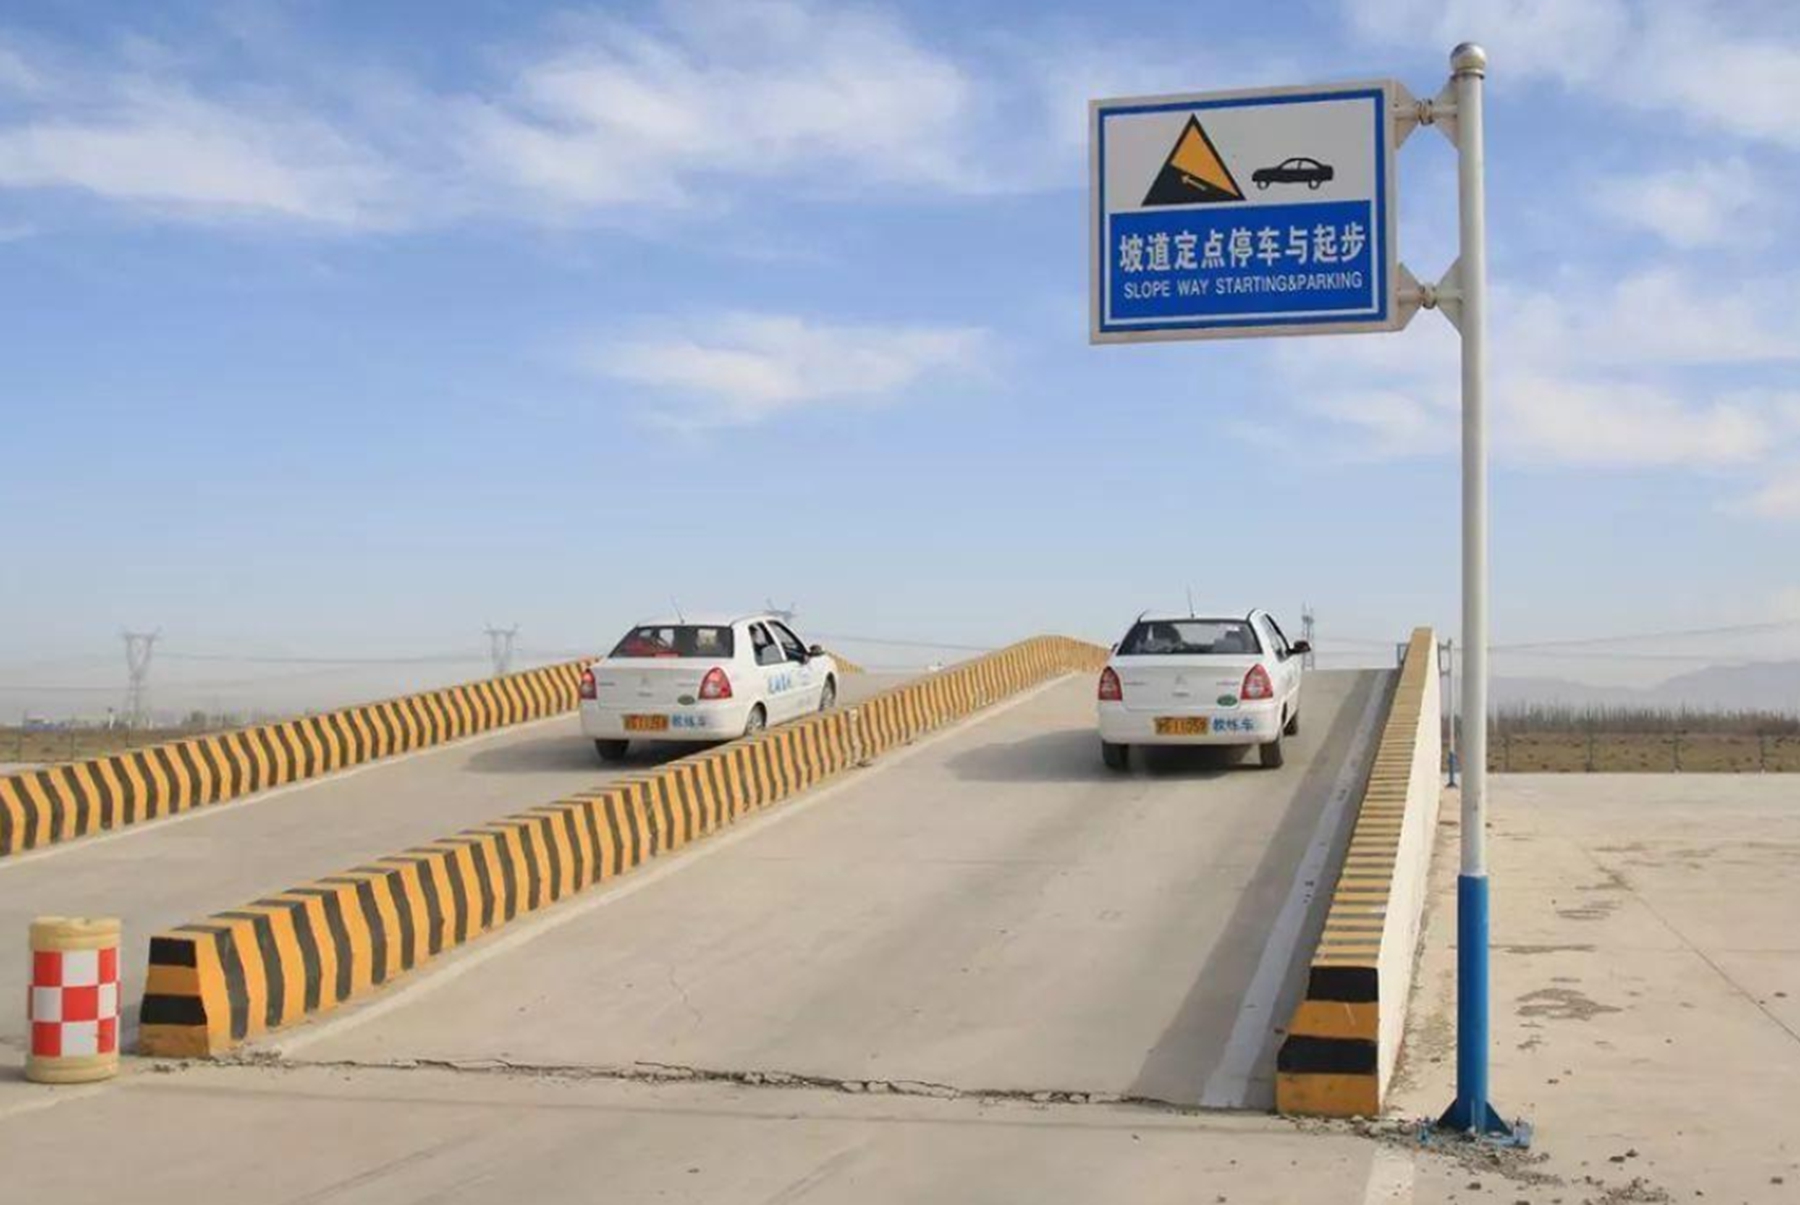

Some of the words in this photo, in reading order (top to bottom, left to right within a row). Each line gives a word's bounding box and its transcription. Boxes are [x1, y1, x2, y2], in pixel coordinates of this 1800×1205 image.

[1118, 221, 1366, 273] 坡道定点停车与起步
[1123, 280, 1171, 299] SLOPE
[1177, 279, 1209, 296] WAY
[1215, 271, 1363, 294] STARTING&PARKING
